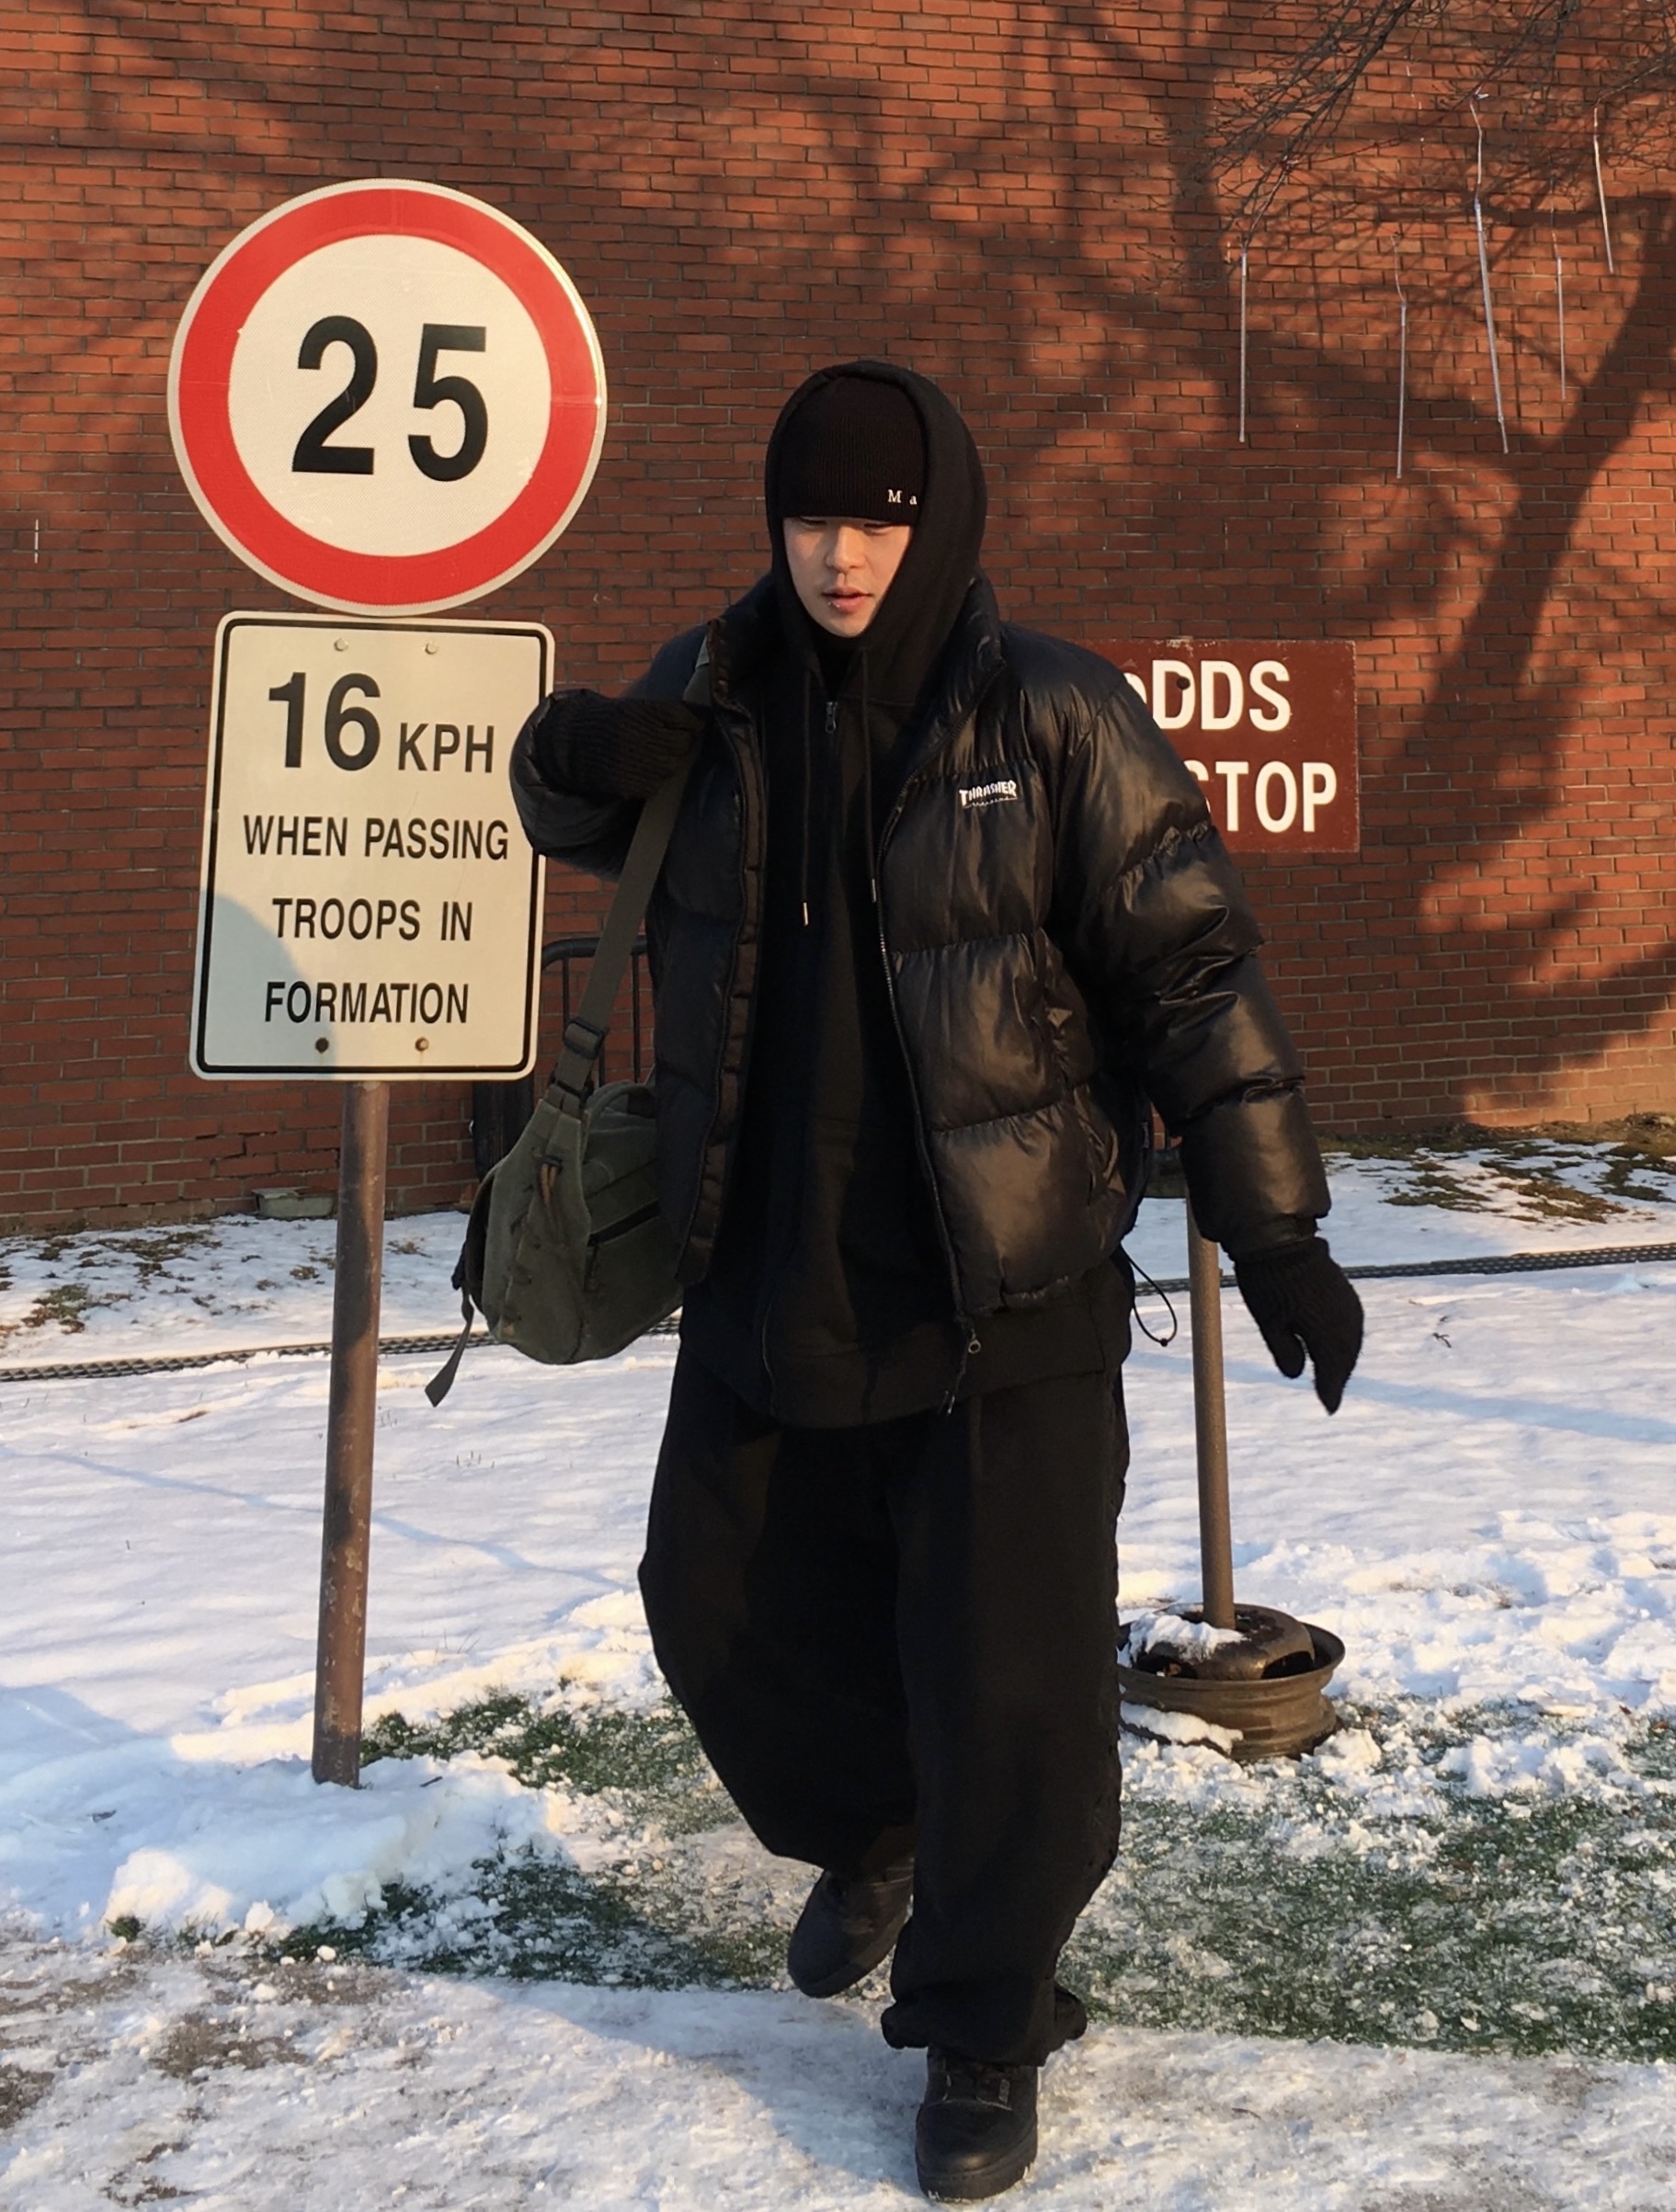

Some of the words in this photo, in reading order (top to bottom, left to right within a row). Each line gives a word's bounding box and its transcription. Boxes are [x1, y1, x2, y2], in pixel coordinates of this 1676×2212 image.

[291, 314, 488, 483] 25
[1123, 659, 1293, 732] DDS
[268, 671, 382, 772] 16
[397, 722, 495, 774] KPH
[959, 780, 1017, 807] THRASHER
[244, 814, 348, 858] WHEN
[364, 816, 509, 861] PASSING
[272, 896, 421, 942] TROOPS
[440, 900, 473, 942] IN
[264, 979, 470, 1025] FORMATION
